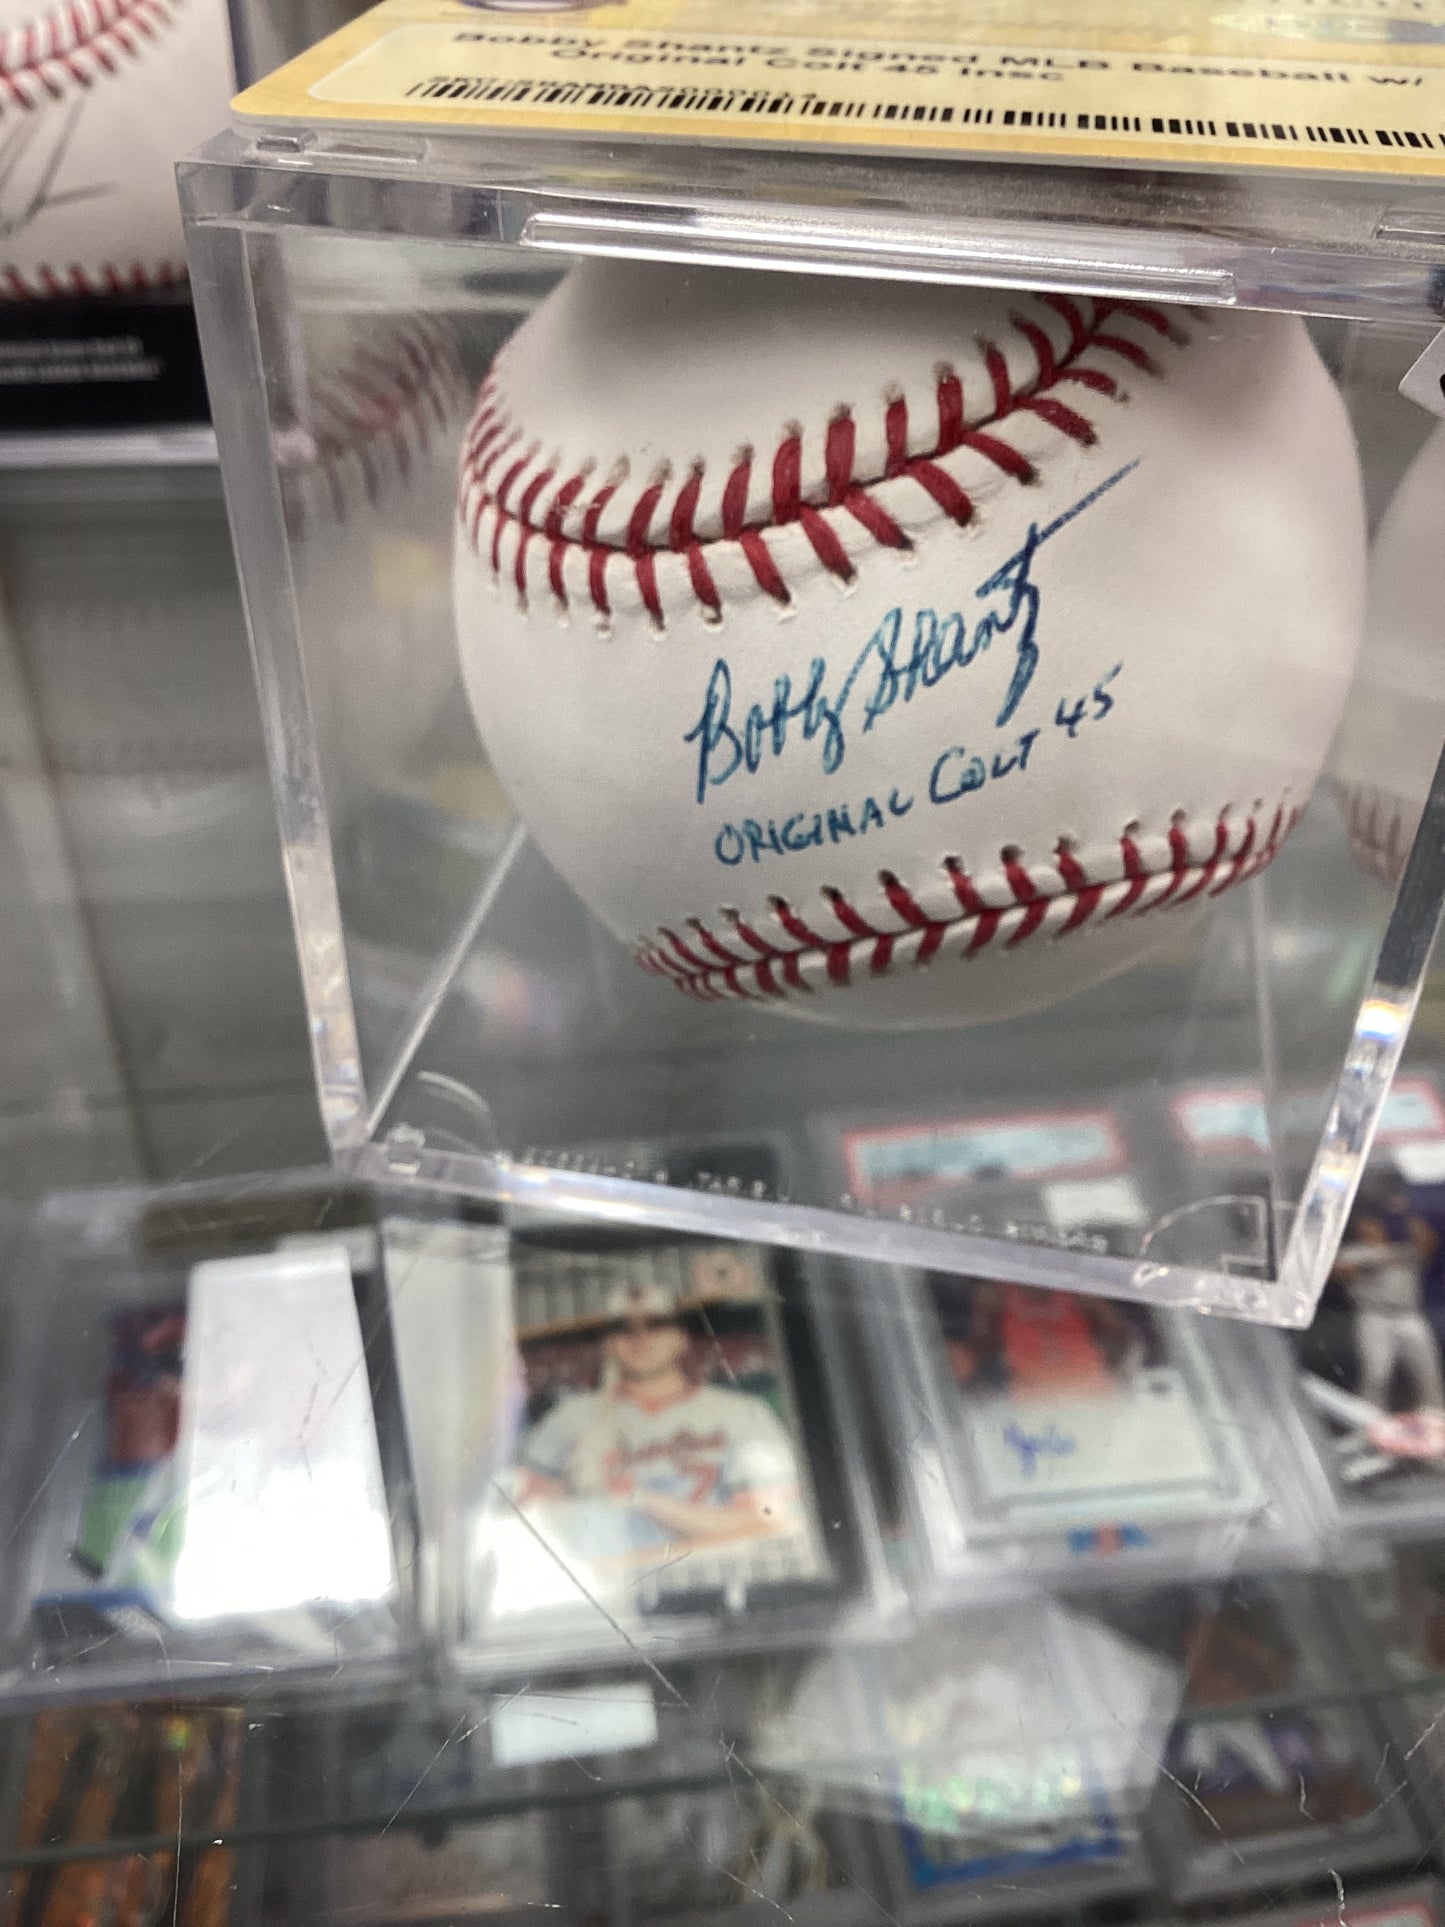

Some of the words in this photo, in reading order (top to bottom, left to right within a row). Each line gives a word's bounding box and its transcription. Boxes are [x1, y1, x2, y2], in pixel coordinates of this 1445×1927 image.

[453, 31, 606, 49] Bobby
[623, 39, 790, 56] Shantz
[806, 46, 980, 66] Signed
[1001, 55, 1110, 71] MLB
[1131, 61, 1351, 84] Baseball
[551, 47, 746, 68] Original
[766, 57, 866, 73] Colt
[882, 63, 940, 76] 45
[959, 67, 1066, 82] Insc
[684, 657, 846, 805] Bobby
[715, 788, 914, 866] ORIGINAL
[1055, 661, 1123, 738] 45
